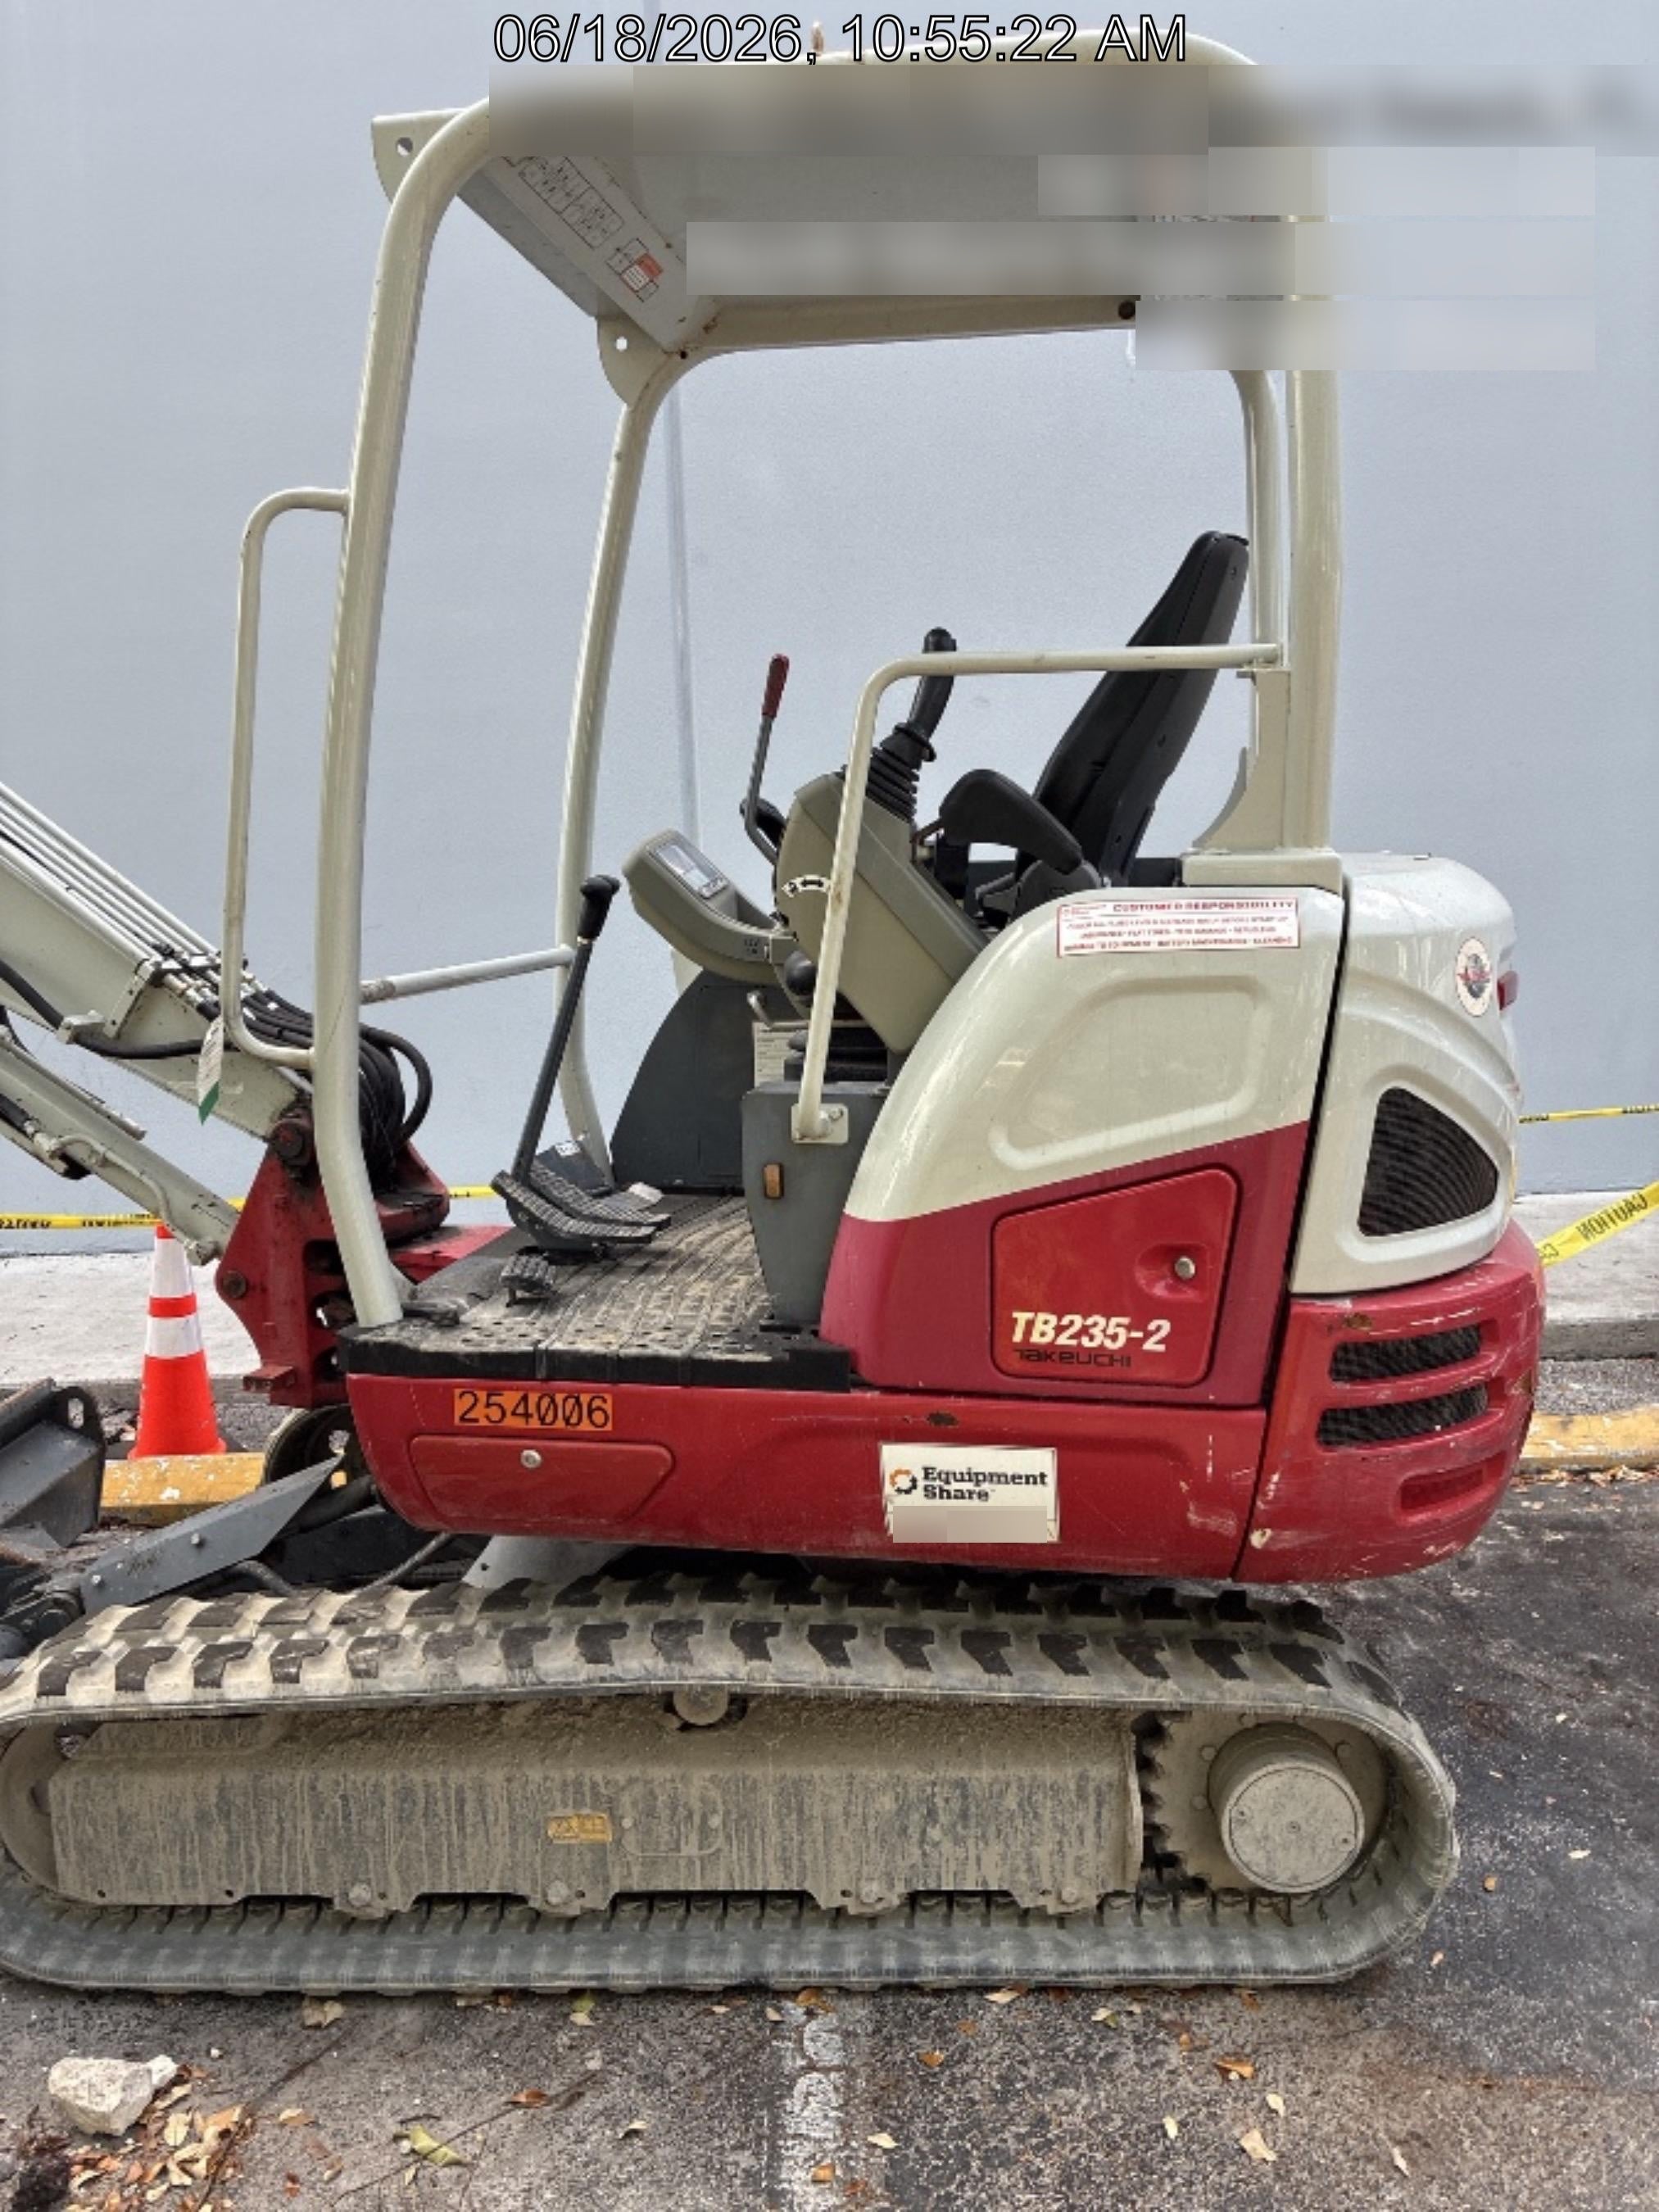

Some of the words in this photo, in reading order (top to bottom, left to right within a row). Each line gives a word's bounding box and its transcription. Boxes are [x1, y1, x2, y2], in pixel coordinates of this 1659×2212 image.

[1012, 1311, 1172, 1353] TB235-2
[459, 1390, 610, 1428] 254006
[922, 1466, 1048, 1488] Equipment
